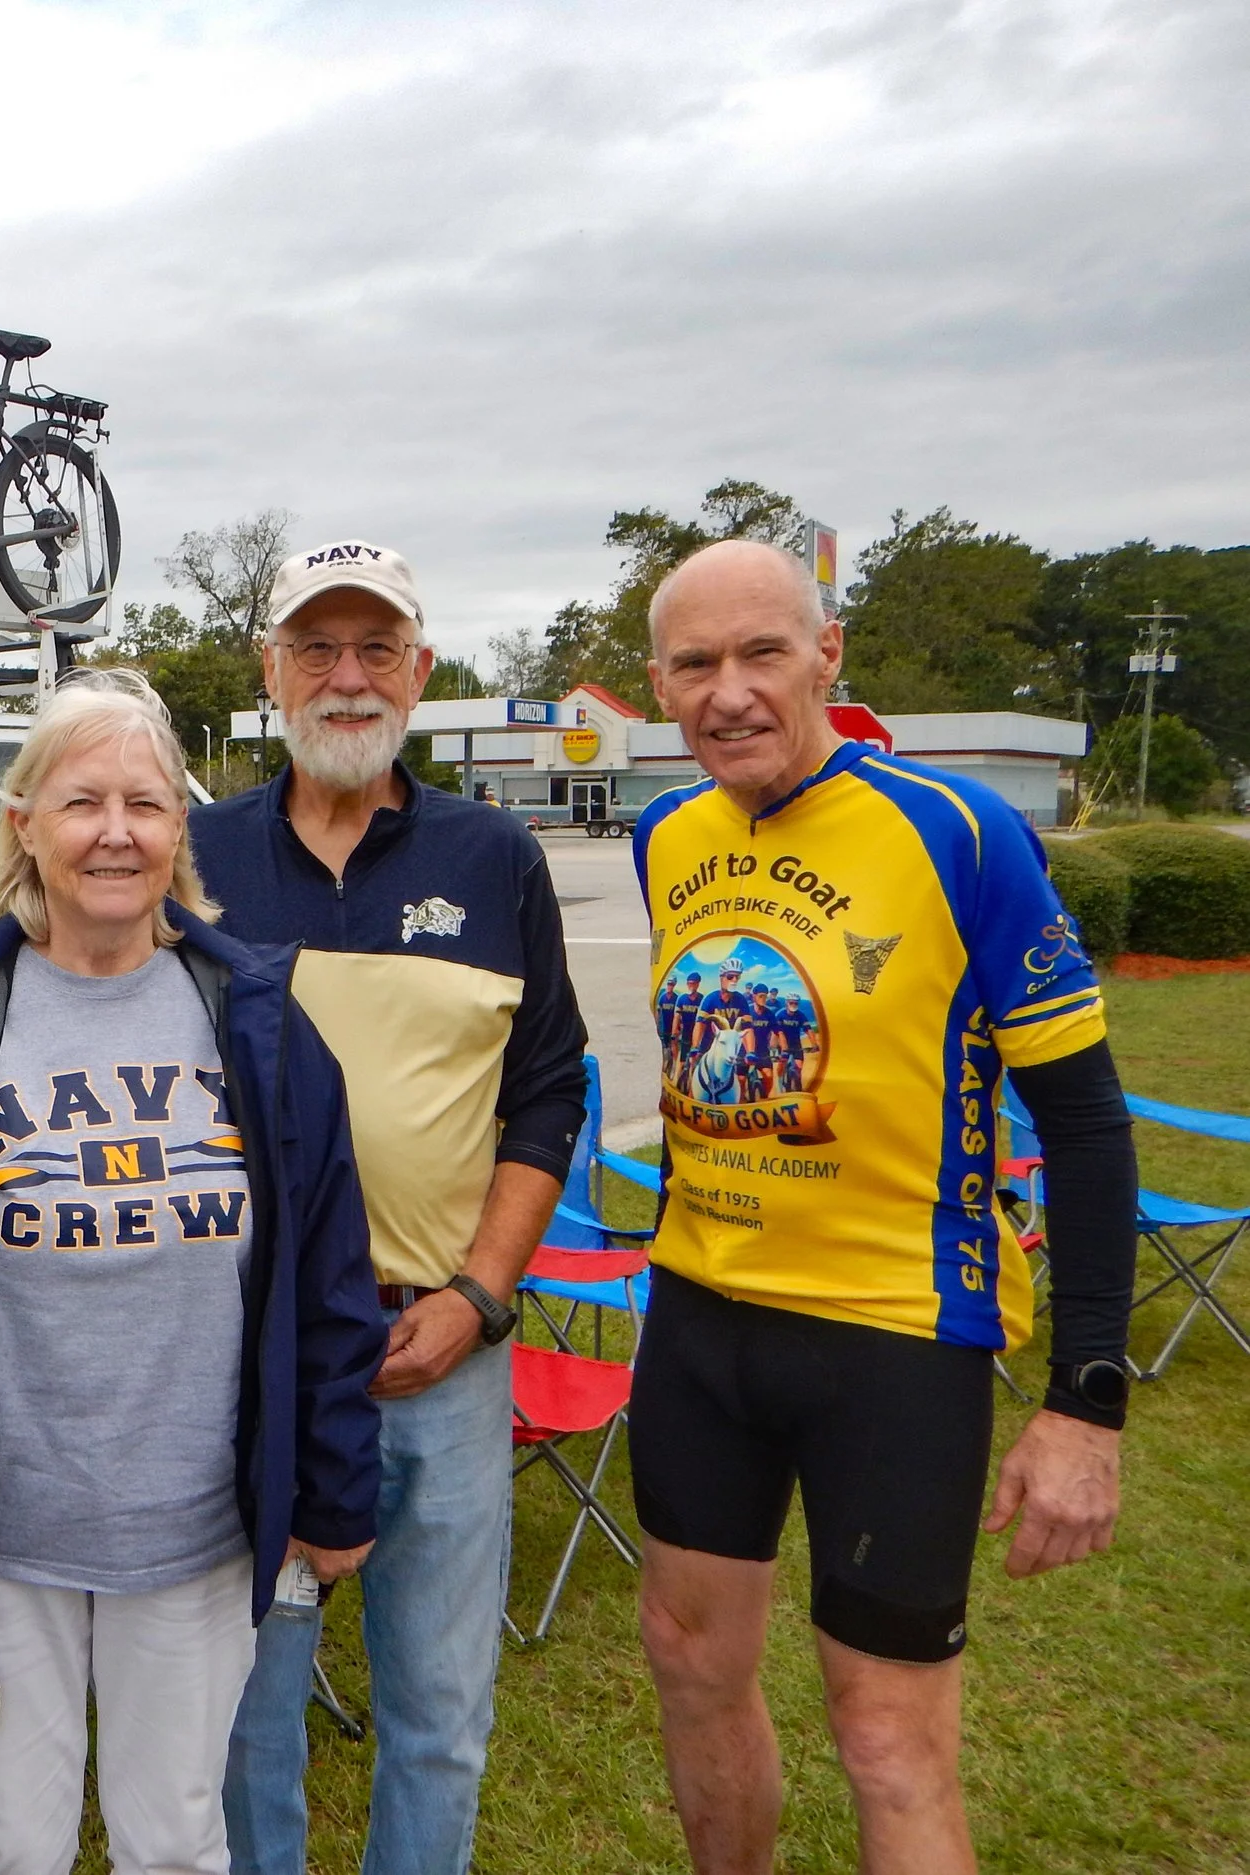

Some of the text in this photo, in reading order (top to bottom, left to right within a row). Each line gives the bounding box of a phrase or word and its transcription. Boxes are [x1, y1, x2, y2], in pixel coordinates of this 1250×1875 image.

[306, 545, 382, 569] NAVY
[514, 702, 547, 722] HORIZON
[668, 852, 851, 921] Gulf to Goat
[674, 897, 823, 941] CHARITY BIKE RIDE
[959, 1005, 996, 1155] CLASS
[664, 1093, 800, 1131] ULF TO GOAT
[102, 1143, 140, 1180] N
[712, 1147, 754, 1173] NAVAL
[759, 1156, 841, 1179] ACADEMY
[680, 1178, 760, 1210] Class of 1975
[0, 1191, 247, 1248] CREW
[706, 1206, 764, 1231] Reunion
[958, 1238, 985, 1292] 75
